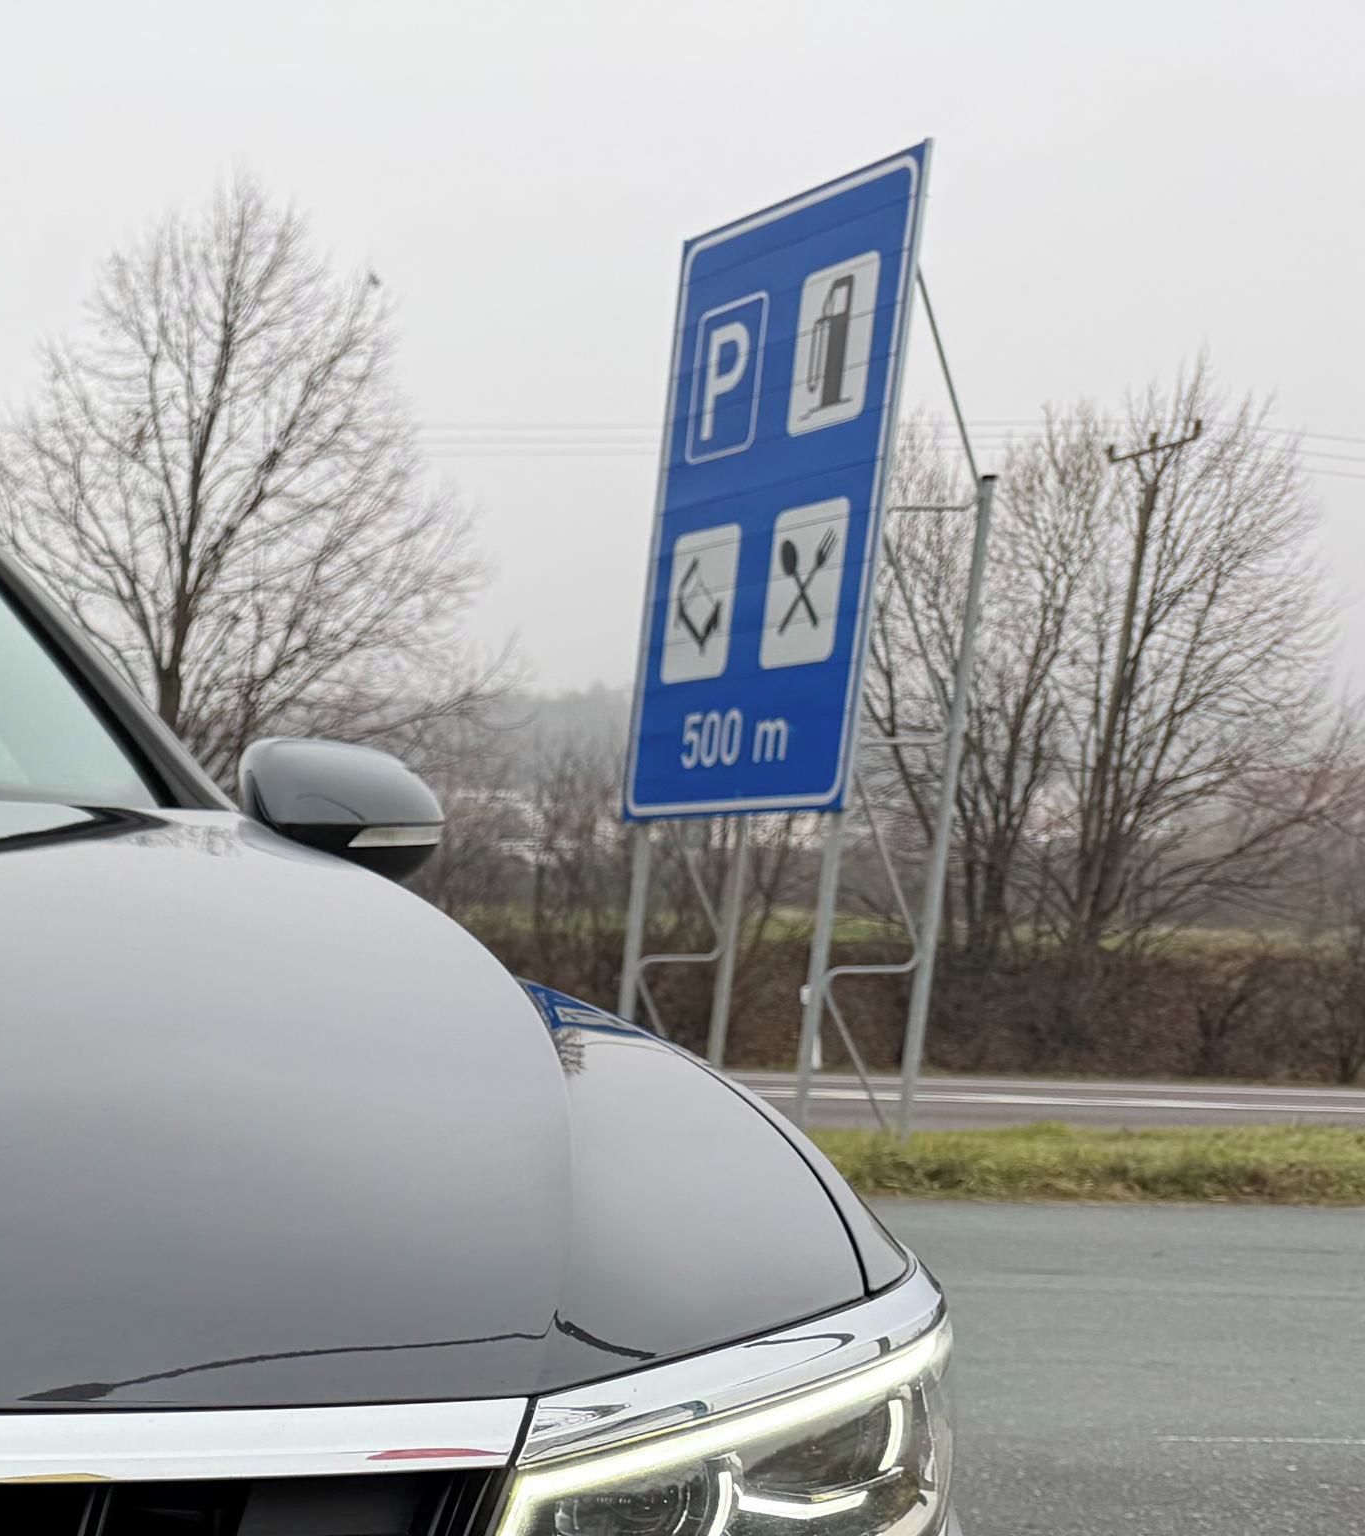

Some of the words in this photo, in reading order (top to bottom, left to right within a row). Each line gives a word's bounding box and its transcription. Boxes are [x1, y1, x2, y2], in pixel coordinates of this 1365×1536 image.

[700, 321, 750, 440] P
[680, 707, 743, 769] 500
[752, 717, 788, 763] m
